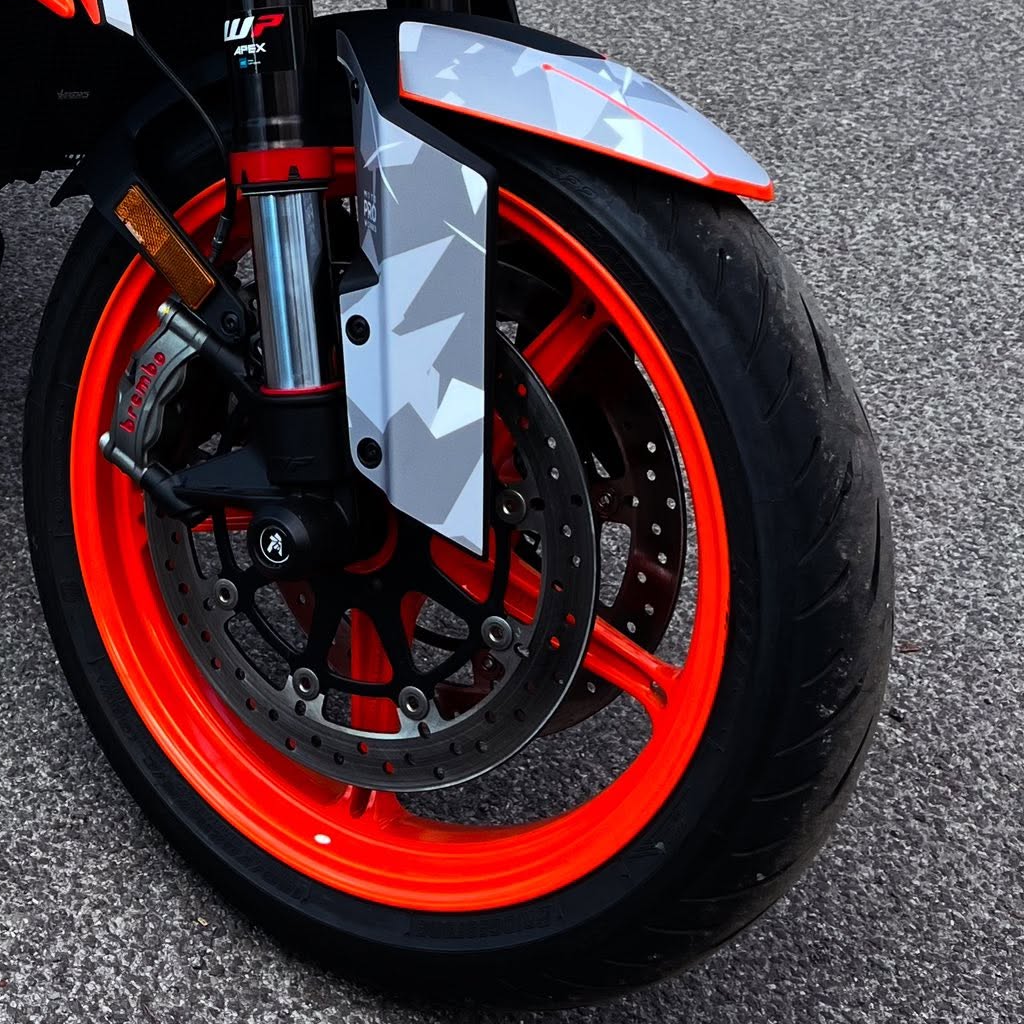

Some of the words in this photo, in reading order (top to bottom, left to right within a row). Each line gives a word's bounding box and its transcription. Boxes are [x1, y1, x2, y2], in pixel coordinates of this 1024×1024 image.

[224, 14, 284, 42] WP
[234, 43, 266, 56] APEX
[120, 352, 166, 433] brembo
